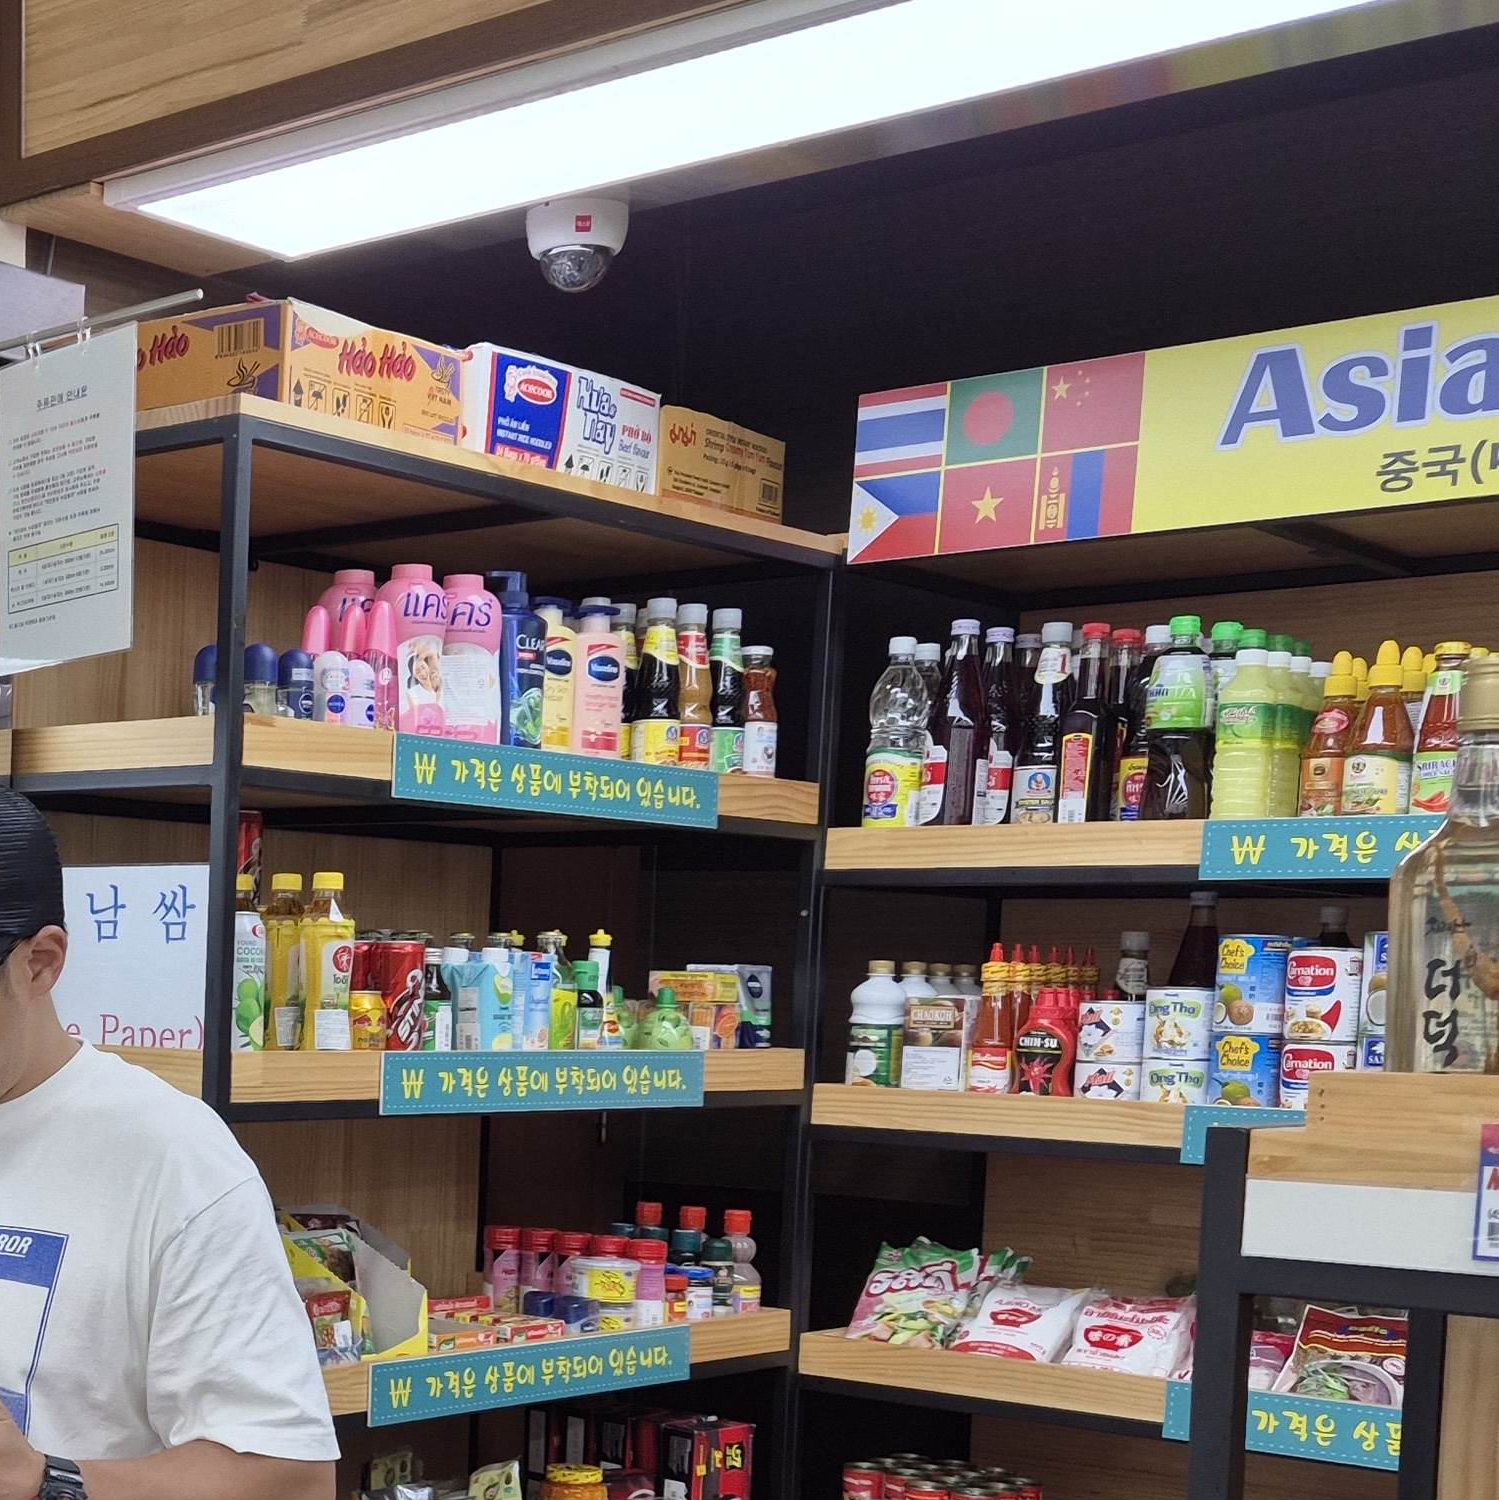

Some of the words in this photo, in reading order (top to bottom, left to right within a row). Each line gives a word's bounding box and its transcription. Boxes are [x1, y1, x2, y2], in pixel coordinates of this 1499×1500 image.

[452, 756, 502, 793] 가격은
[509, 764, 562, 796] 상품에
[568, 768, 631, 803] 부착되어
[636, 775, 701, 811] 있습니다.
[1290, 831, 1379, 865] 가격은
[86, 884, 127, 944] 남
[153, 884, 197, 945] 쌈
[1220, 959, 1245, 970] Choice
[1221, 945, 1245, 958] Chef's
[100, 1013, 204, 1049] Paper)
[1423, 958, 1462, 1069] 더덕
[1018, 1035, 1059, 1049] CHIN-SU
[1221, 1041, 1250, 1055] Chef's
[1220, 1054, 1250, 1067] Choice
[438, 1066, 489, 1098] 가격은
[497, 1066, 548, 1096] 상품에
[554, 1064, 617, 1094] 부착되어
[621, 1063, 687, 1095] 있습니다.
[426, 1370, 475, 1400] 가격은
[483, 1361, 535, 1394] 상품에
[541, 1353, 603, 1387] 부착되어
[609, 1344, 673, 1377] 있습니다.
[1250, 1408, 1338, 1448] 가격은
